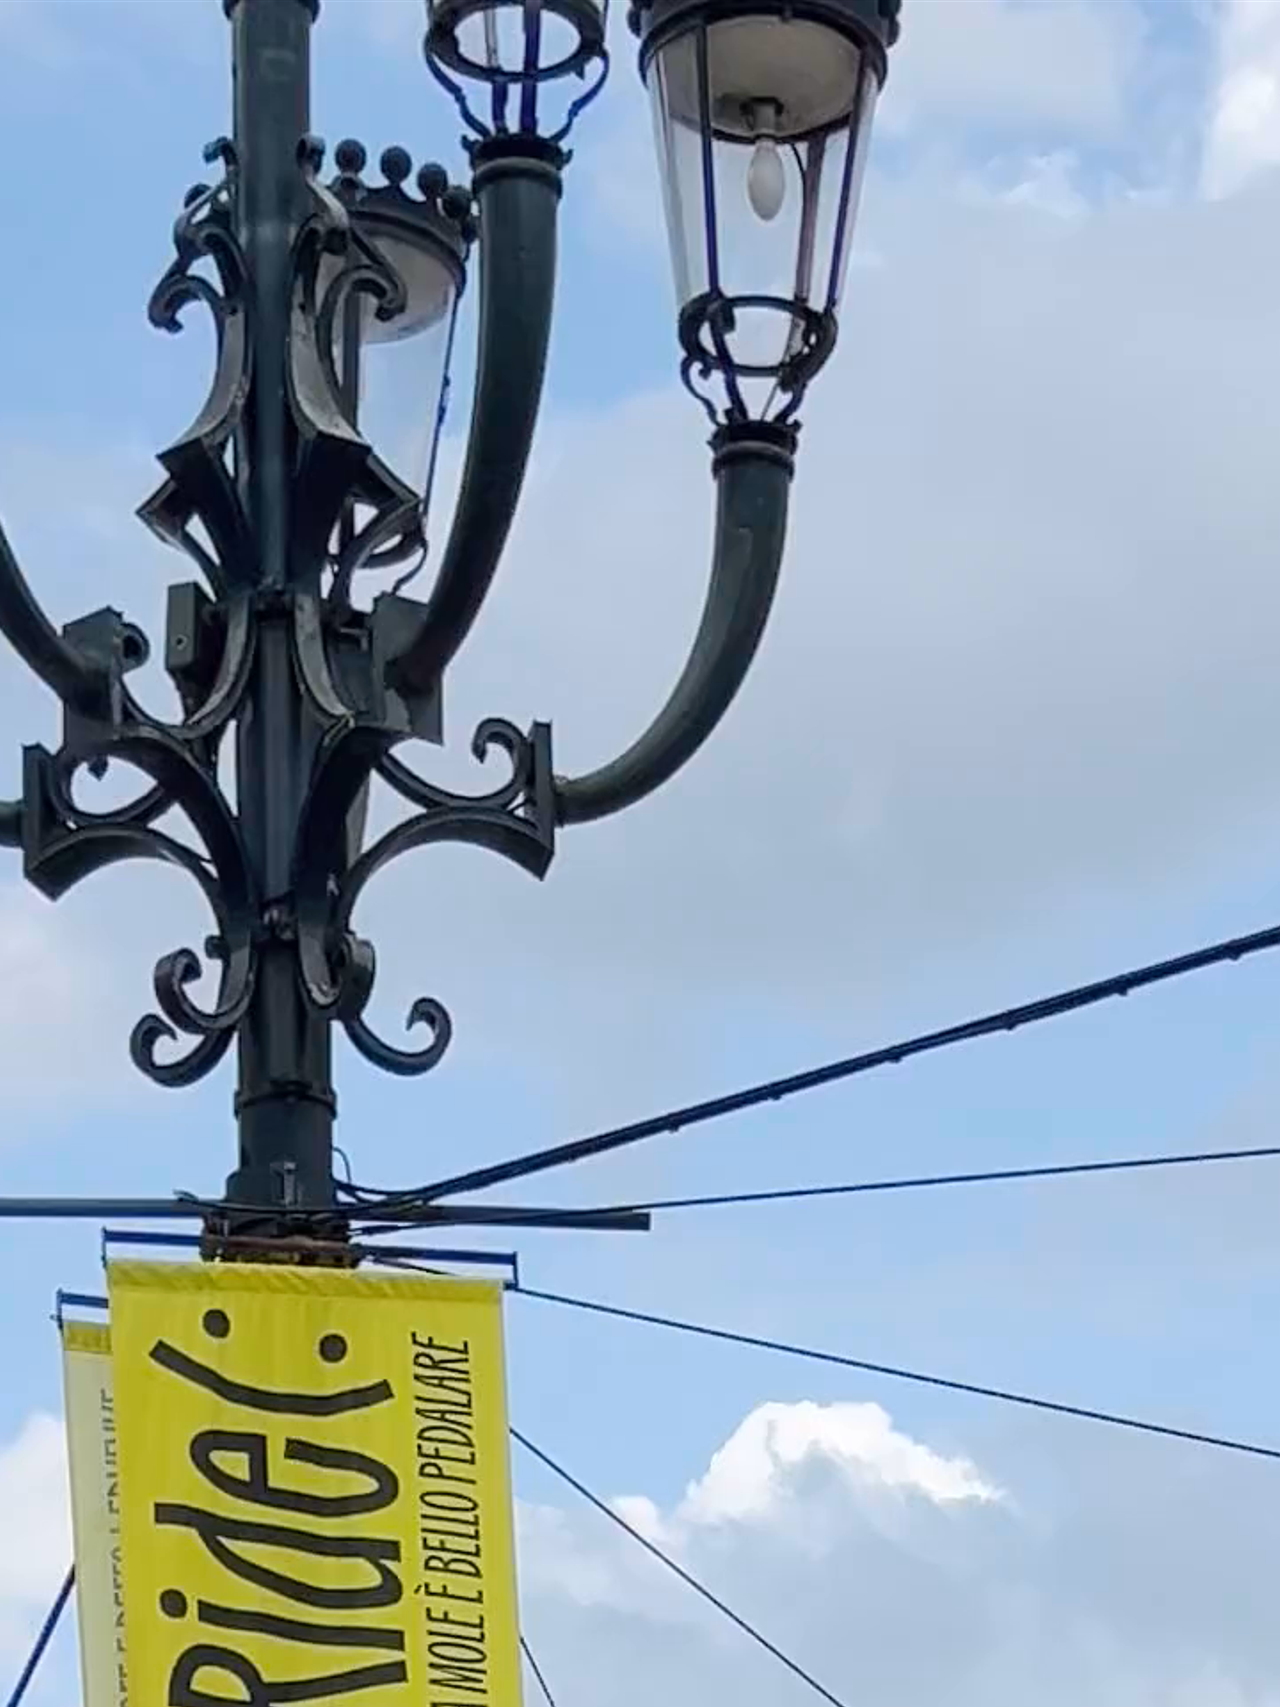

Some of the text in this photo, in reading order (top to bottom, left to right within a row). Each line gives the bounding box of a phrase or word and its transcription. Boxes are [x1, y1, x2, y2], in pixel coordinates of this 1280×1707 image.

[411, 1331, 477, 1485] PEDALARE
[418, 1491, 482, 1579] BELLO
[414, 1582, 484, 1604] È
[425, 1607, 488, 1694] MOLE
